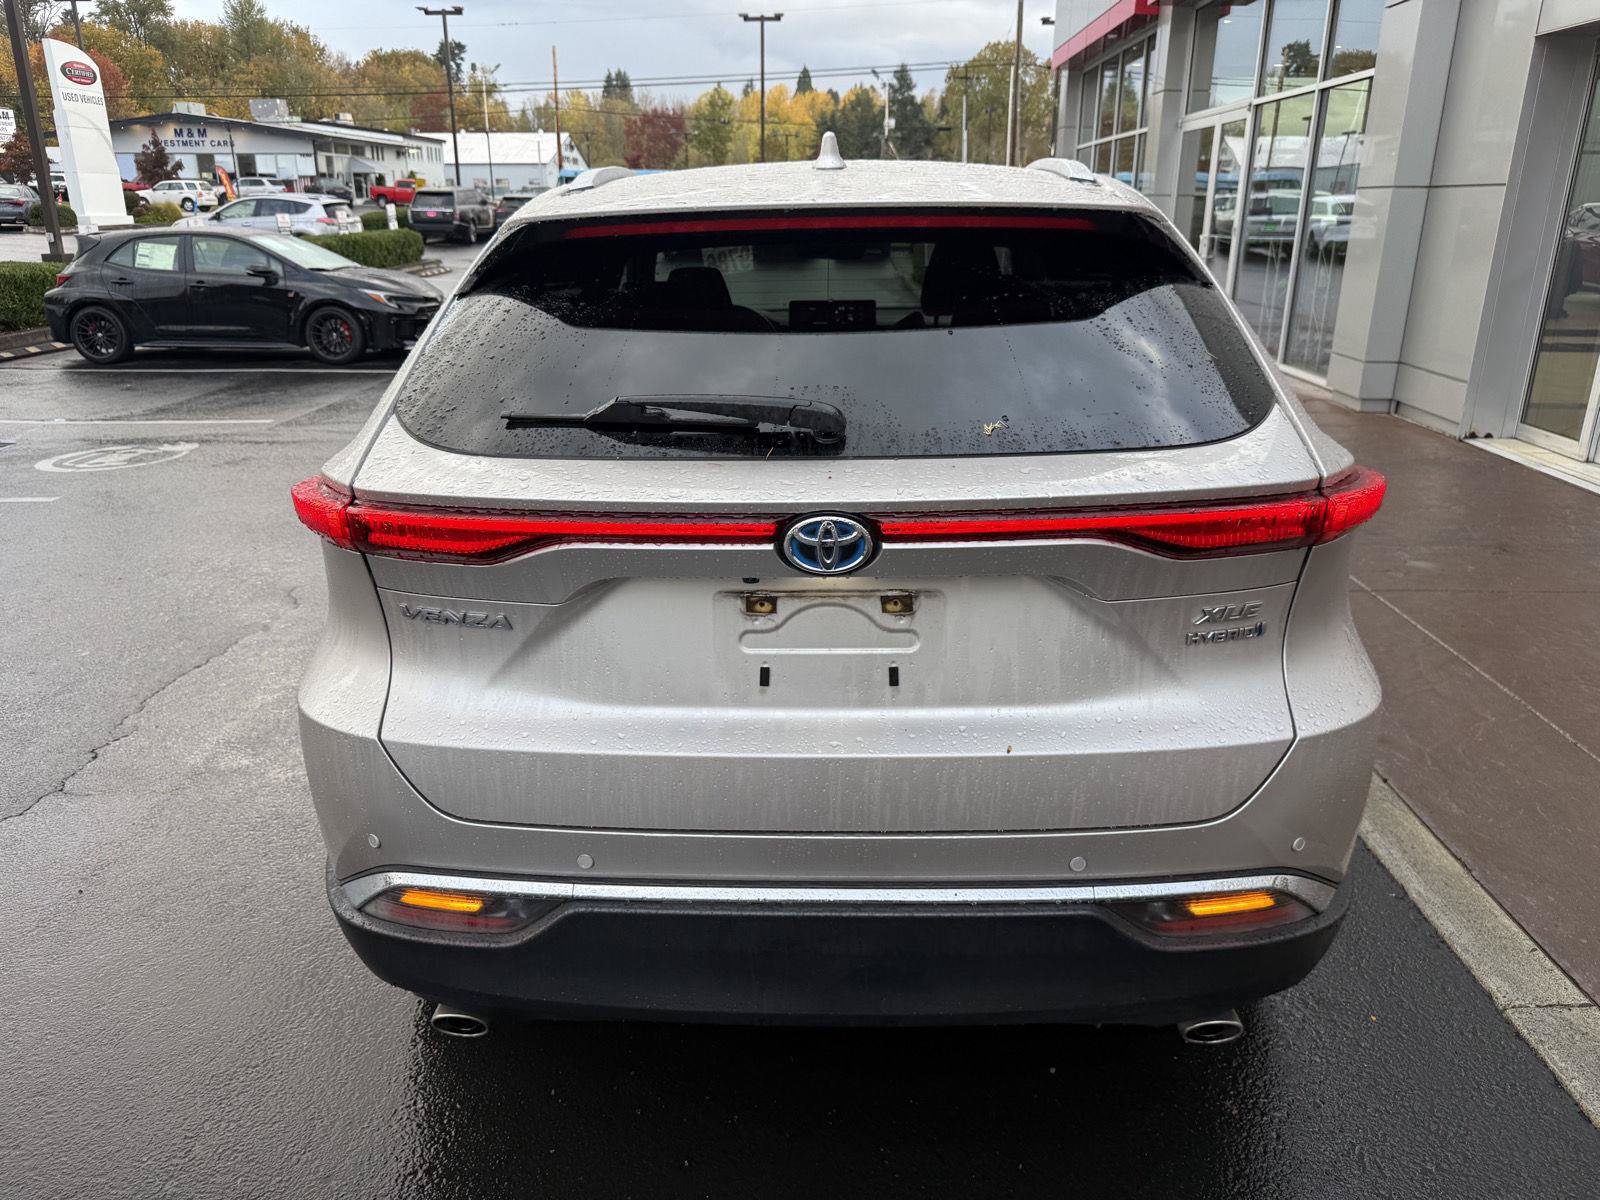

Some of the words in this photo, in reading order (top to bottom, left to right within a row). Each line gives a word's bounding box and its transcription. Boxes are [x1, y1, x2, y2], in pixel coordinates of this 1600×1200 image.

[62, 91, 79, 102] USED
[80, 94, 104, 106] VEHICLES
[174, 128, 183, 138] M
[187, 128, 194, 138] &
[197, 128, 208, 138] M
[400, 603, 513, 630] VENZA
[1193, 601, 1262, 624] XLE
[1185, 626, 1257, 646] HYBRID
